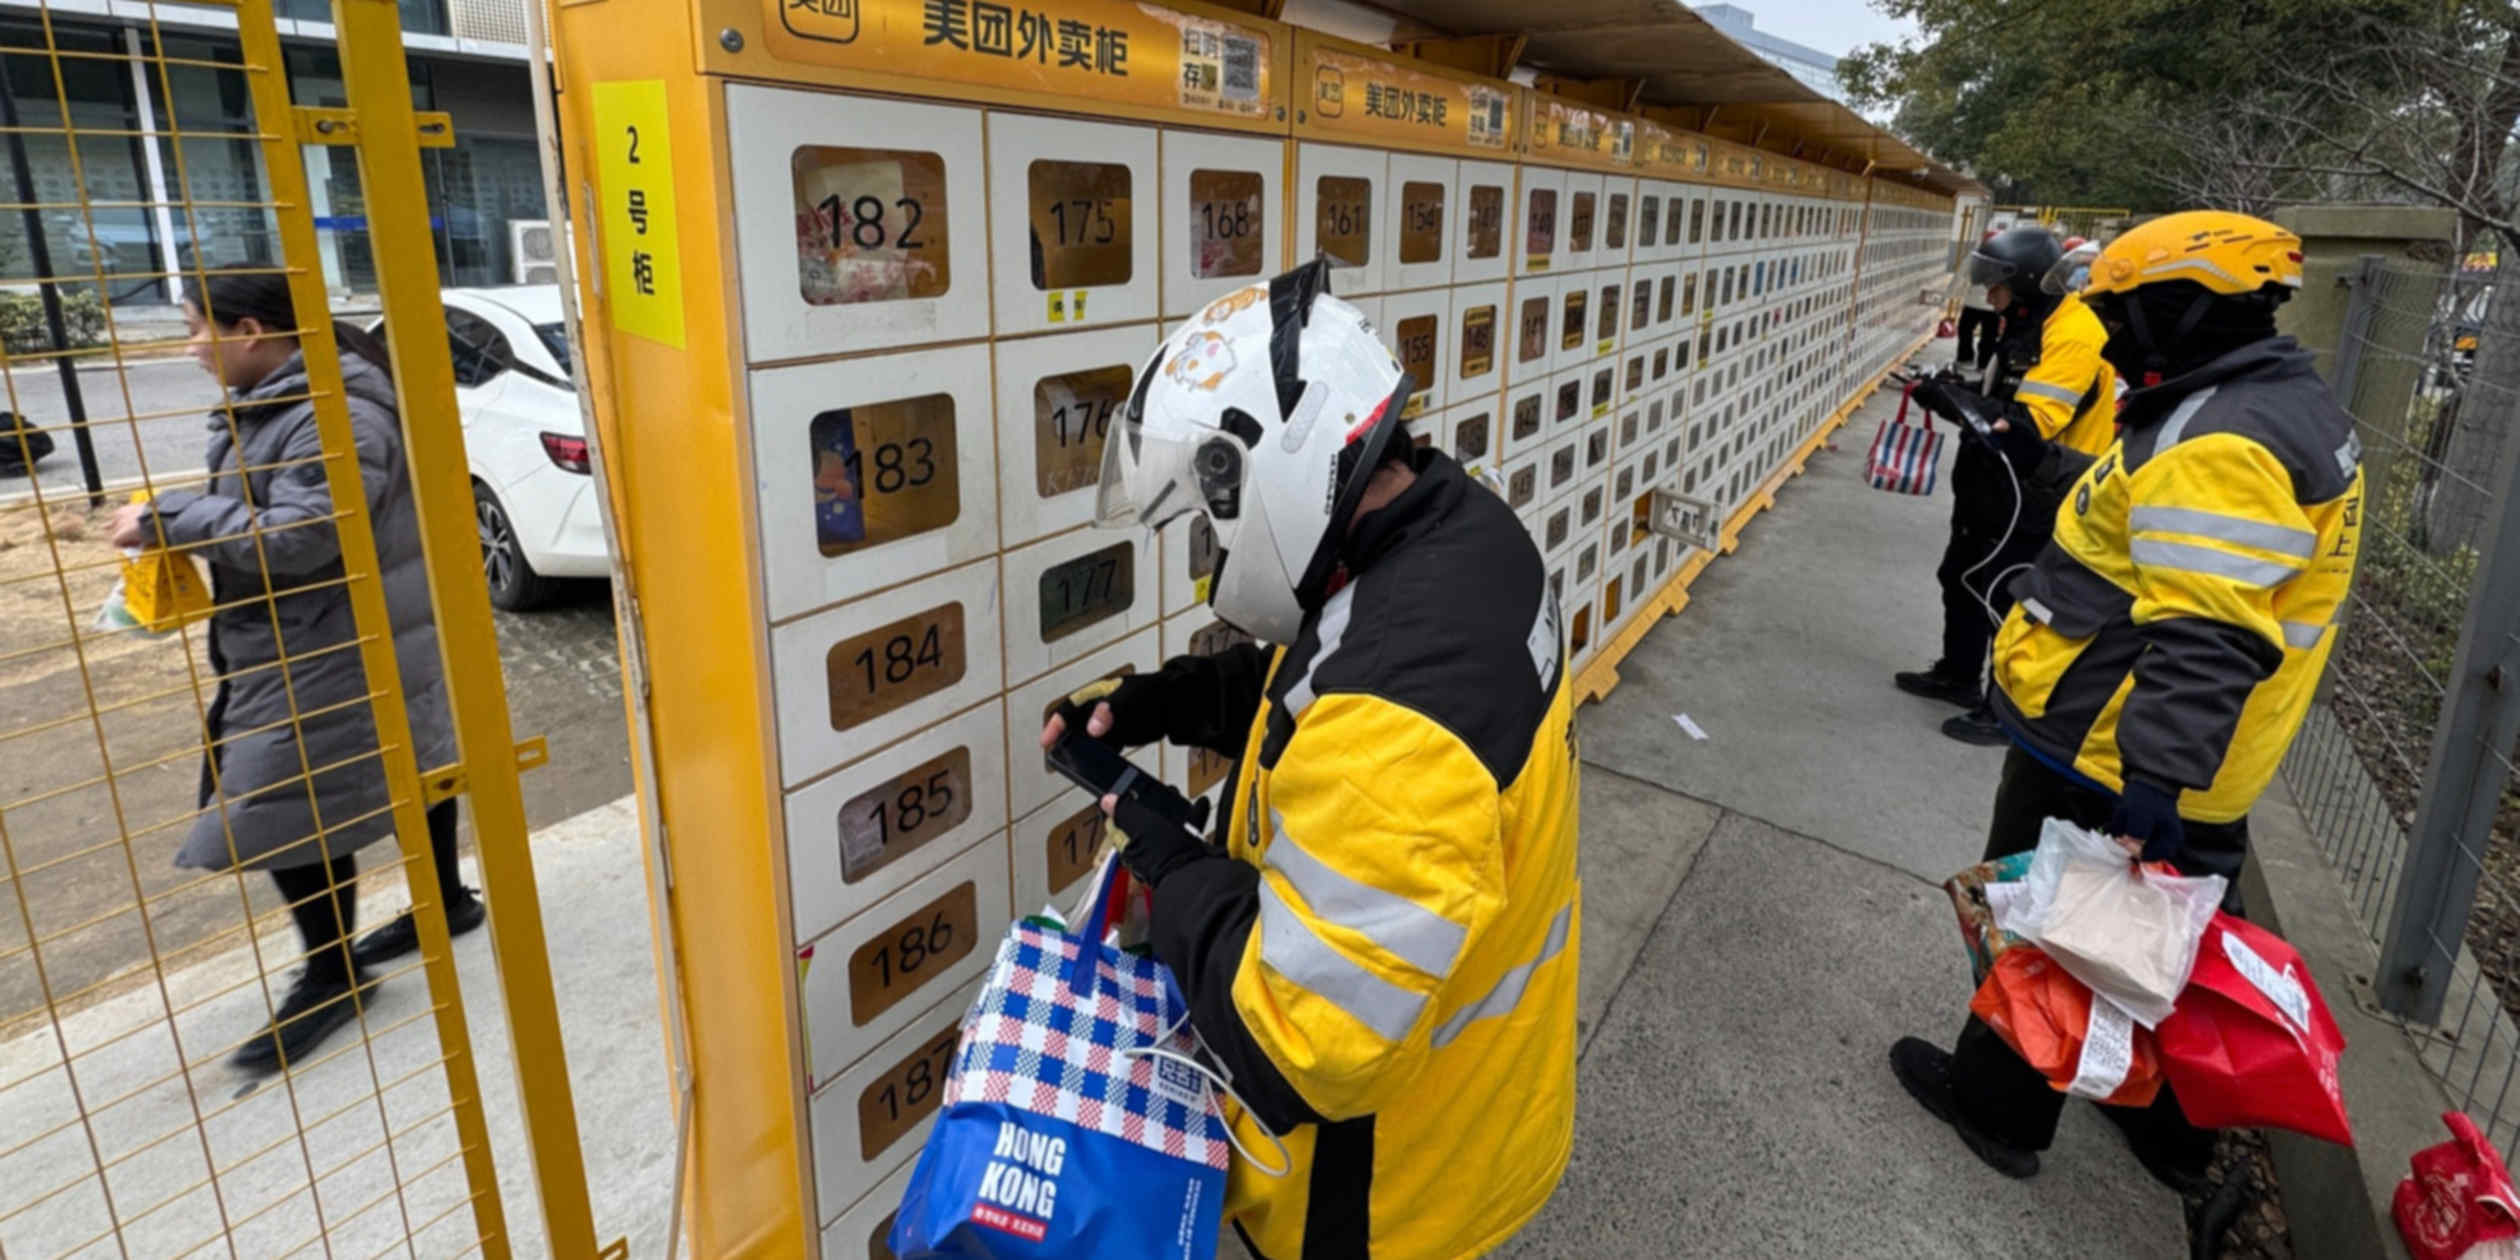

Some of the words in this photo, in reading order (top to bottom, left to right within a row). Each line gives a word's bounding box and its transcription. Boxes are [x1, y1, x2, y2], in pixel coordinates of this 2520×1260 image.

[923, 0, 1128, 77] 美团外卖柜
[1365, 82, 1447, 128] 美团外卖柜
[818, 193, 924, 250] 182
[1050, 199, 1116, 247] 175
[1202, 201, 1250, 241] 168
[1327, 202, 1362, 236] 161
[1408, 203, 1435, 232] 154
[1402, 334, 1431, 364] 155
[845, 437, 937, 500] 183
[1058, 558, 1118, 613] 177
[855, 623, 944, 695] 184
[869, 768, 953, 849] 185
[1064, 814, 1101, 865] 17
[872, 911, 953, 988] 186
[880, 1036, 956, 1121] 187
[993, 1121, 1067, 1177] HONG
[978, 1160, 1057, 1220] KONG
